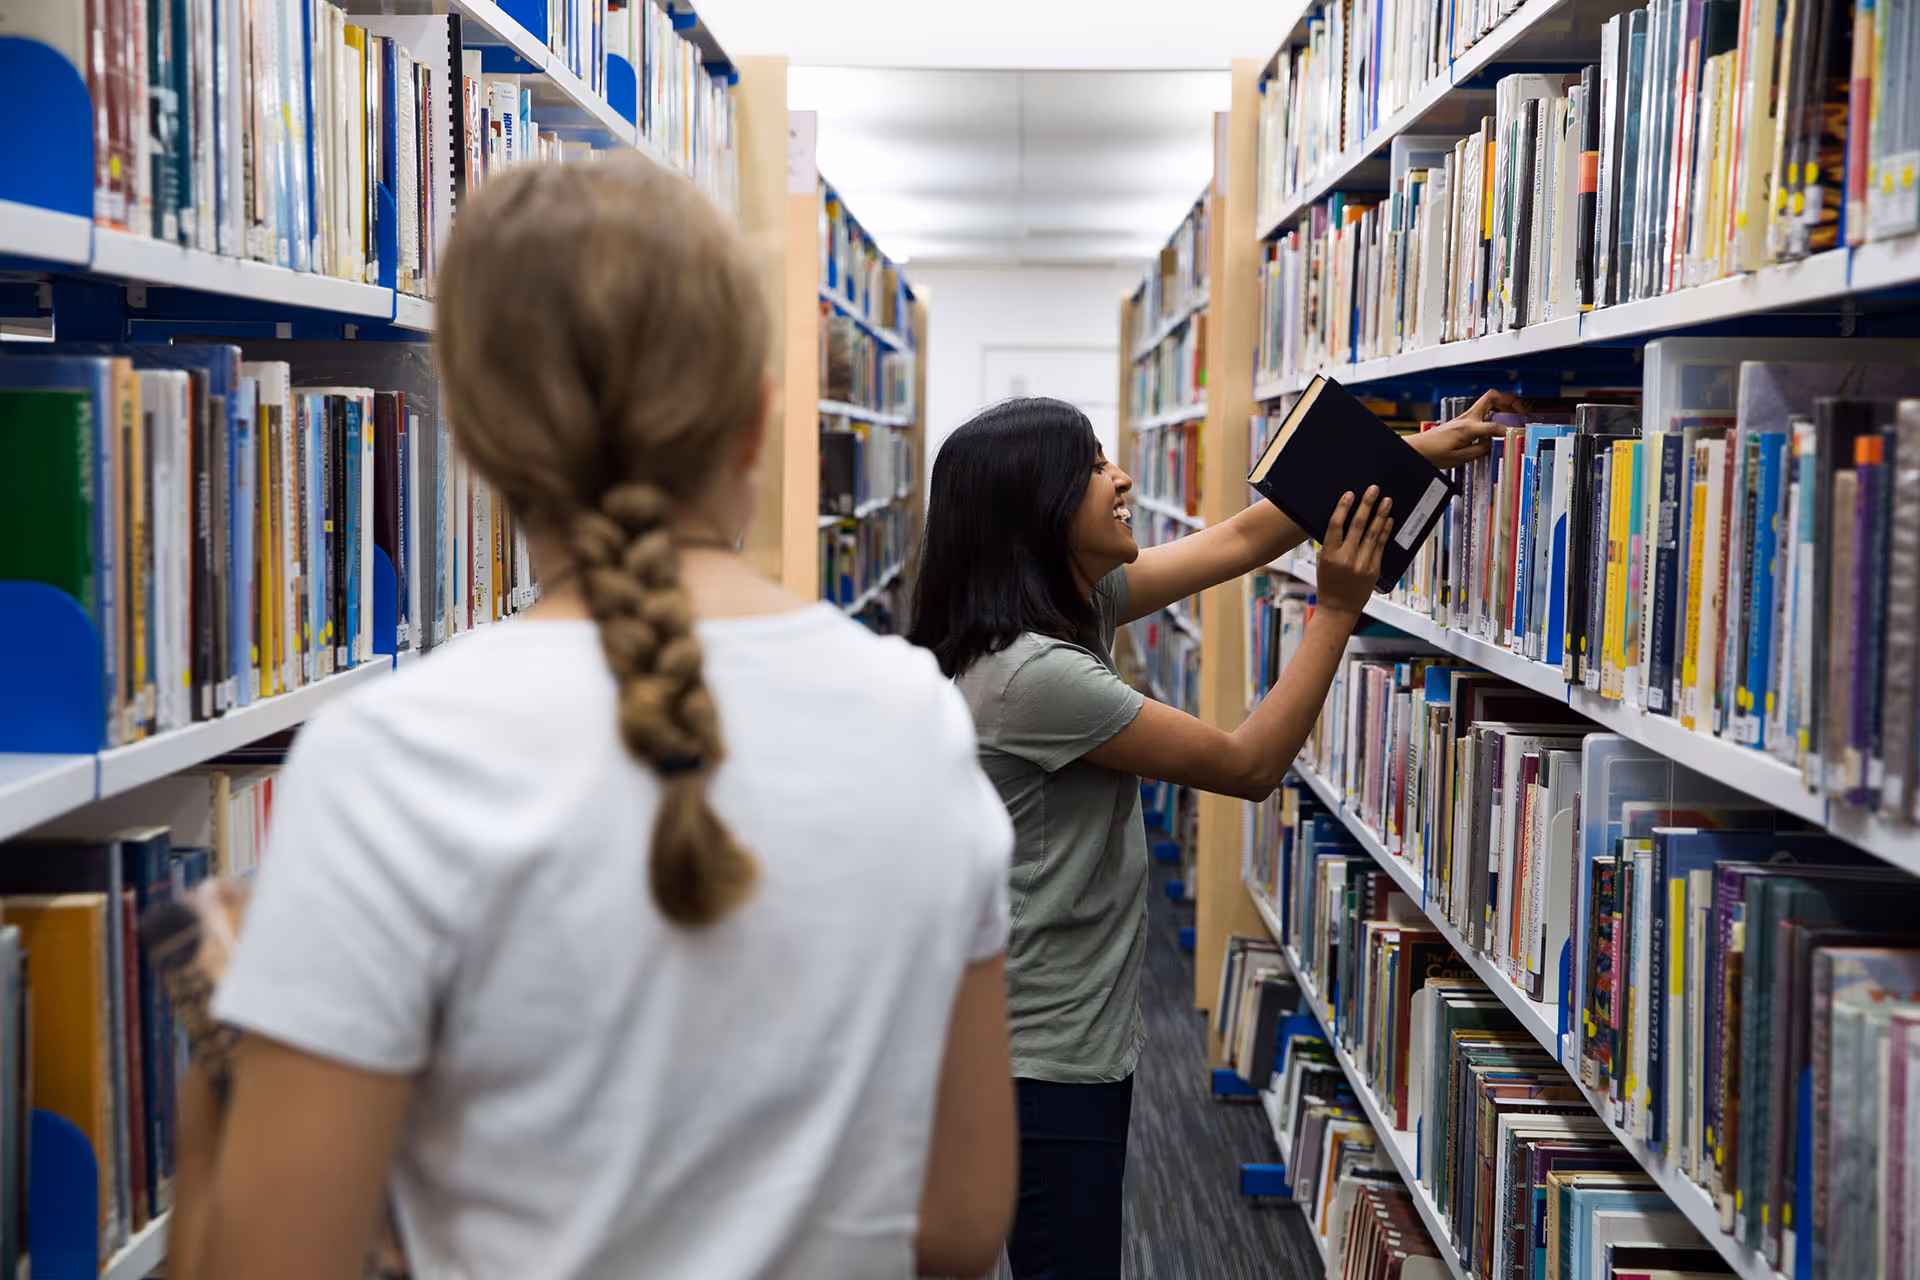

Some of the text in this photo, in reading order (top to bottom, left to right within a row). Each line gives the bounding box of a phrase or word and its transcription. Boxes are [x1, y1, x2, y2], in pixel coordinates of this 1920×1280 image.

[1642, 544, 1650, 596] PRIMAL
[1639, 603, 1647, 664] SCREAM
[1522, 792, 1532, 879] BREAKDOWN
[1532, 869, 1541, 936] HANDBOOK
[1611, 919, 1619, 974] Narrative
